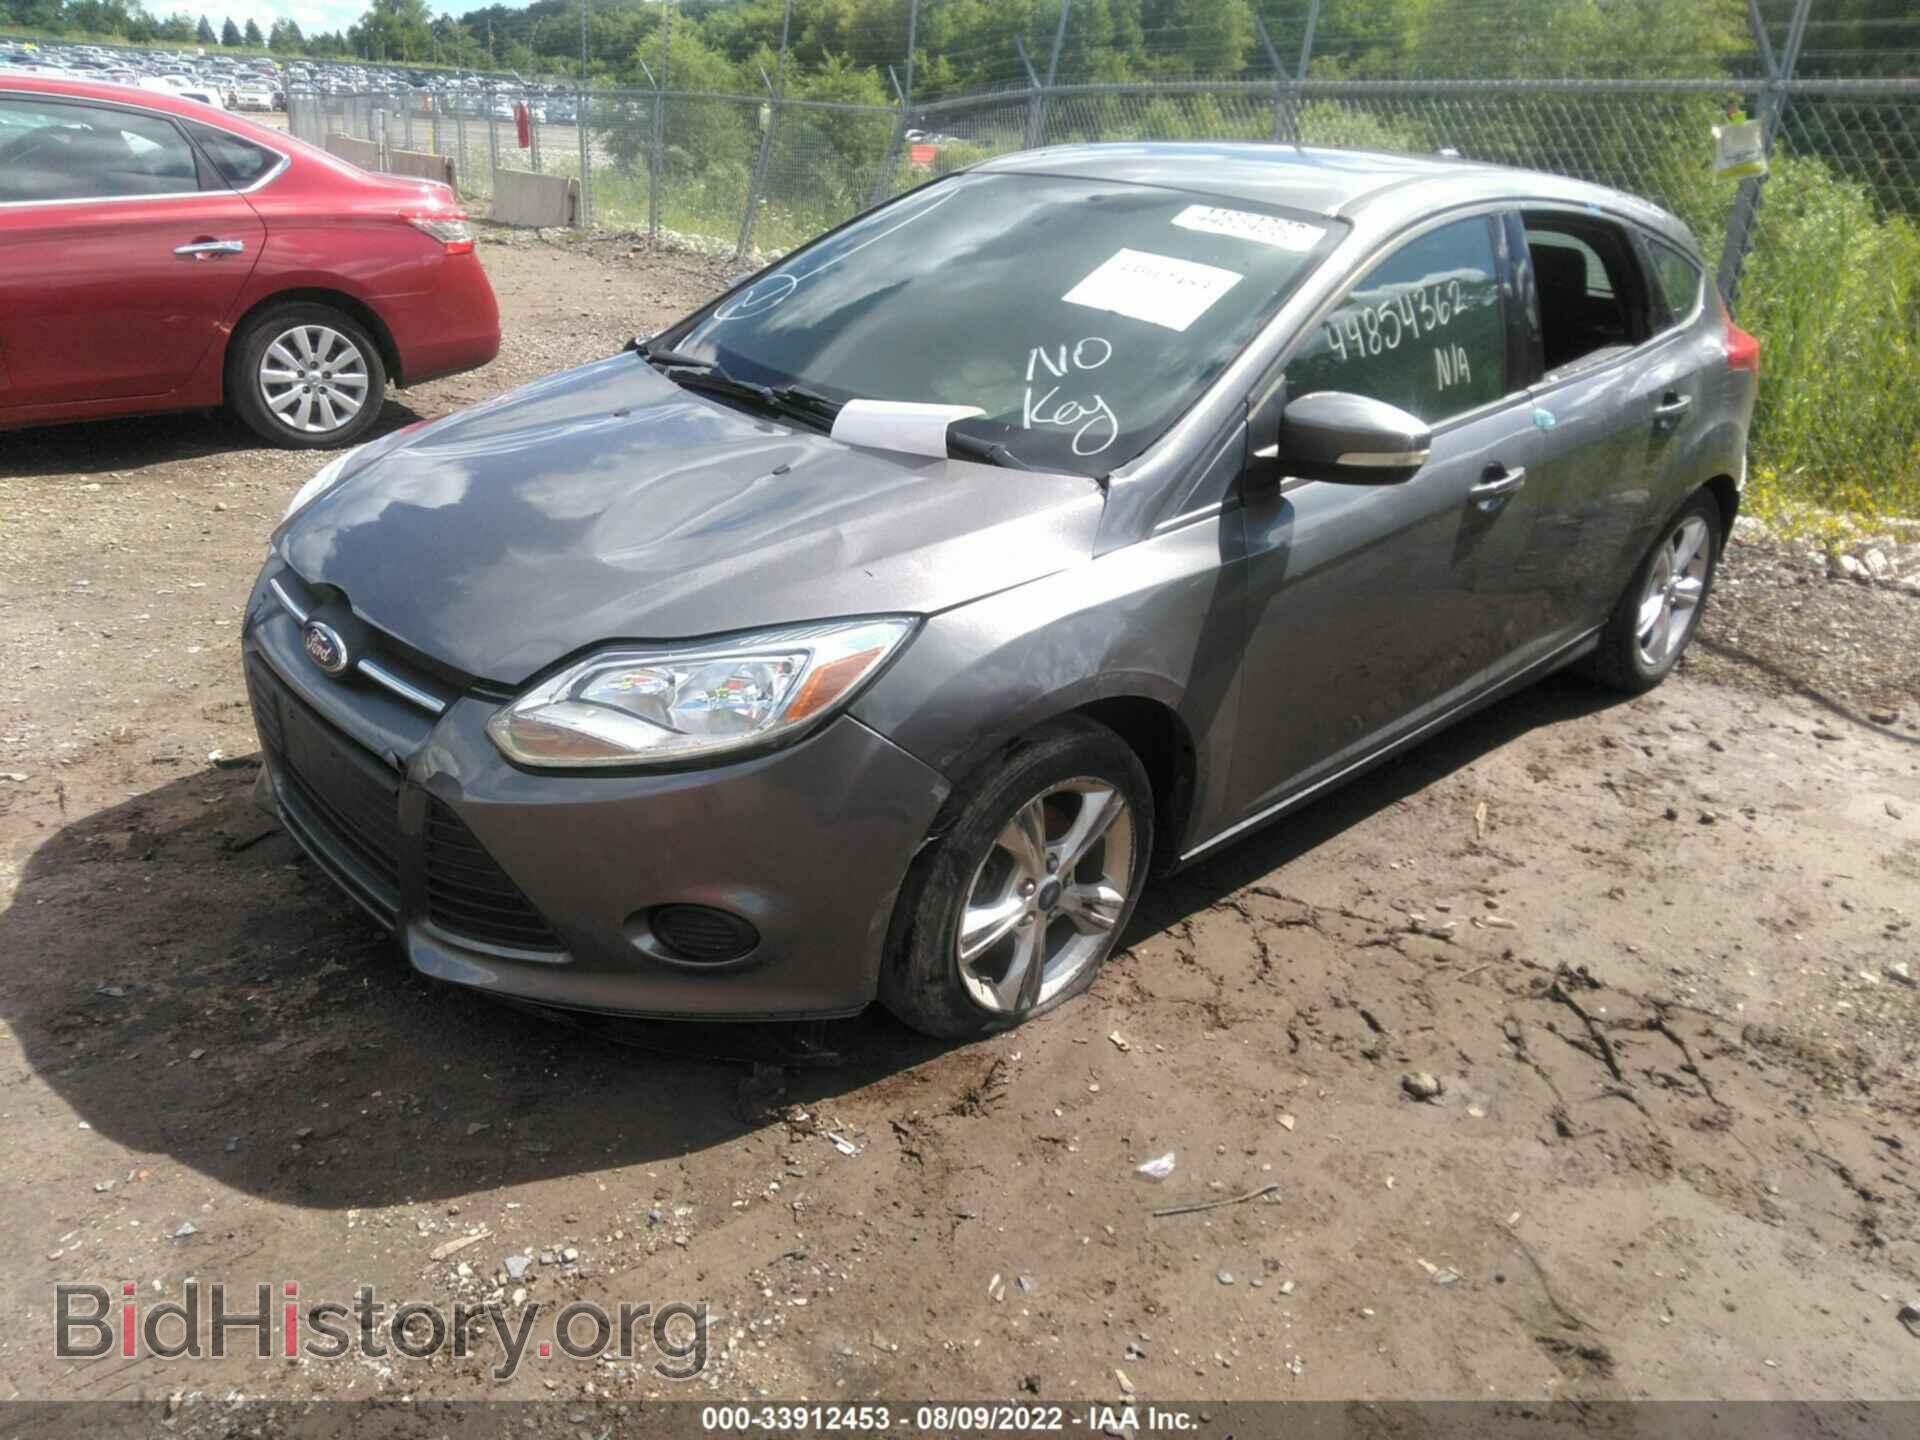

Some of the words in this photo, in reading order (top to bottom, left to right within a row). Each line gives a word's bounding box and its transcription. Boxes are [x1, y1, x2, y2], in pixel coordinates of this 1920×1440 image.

[1026, 337, 1112, 381] NO
[1434, 344, 1472, 391] N/A
[1024, 386, 1118, 455] Key
[306, 628, 333, 662] Ford
